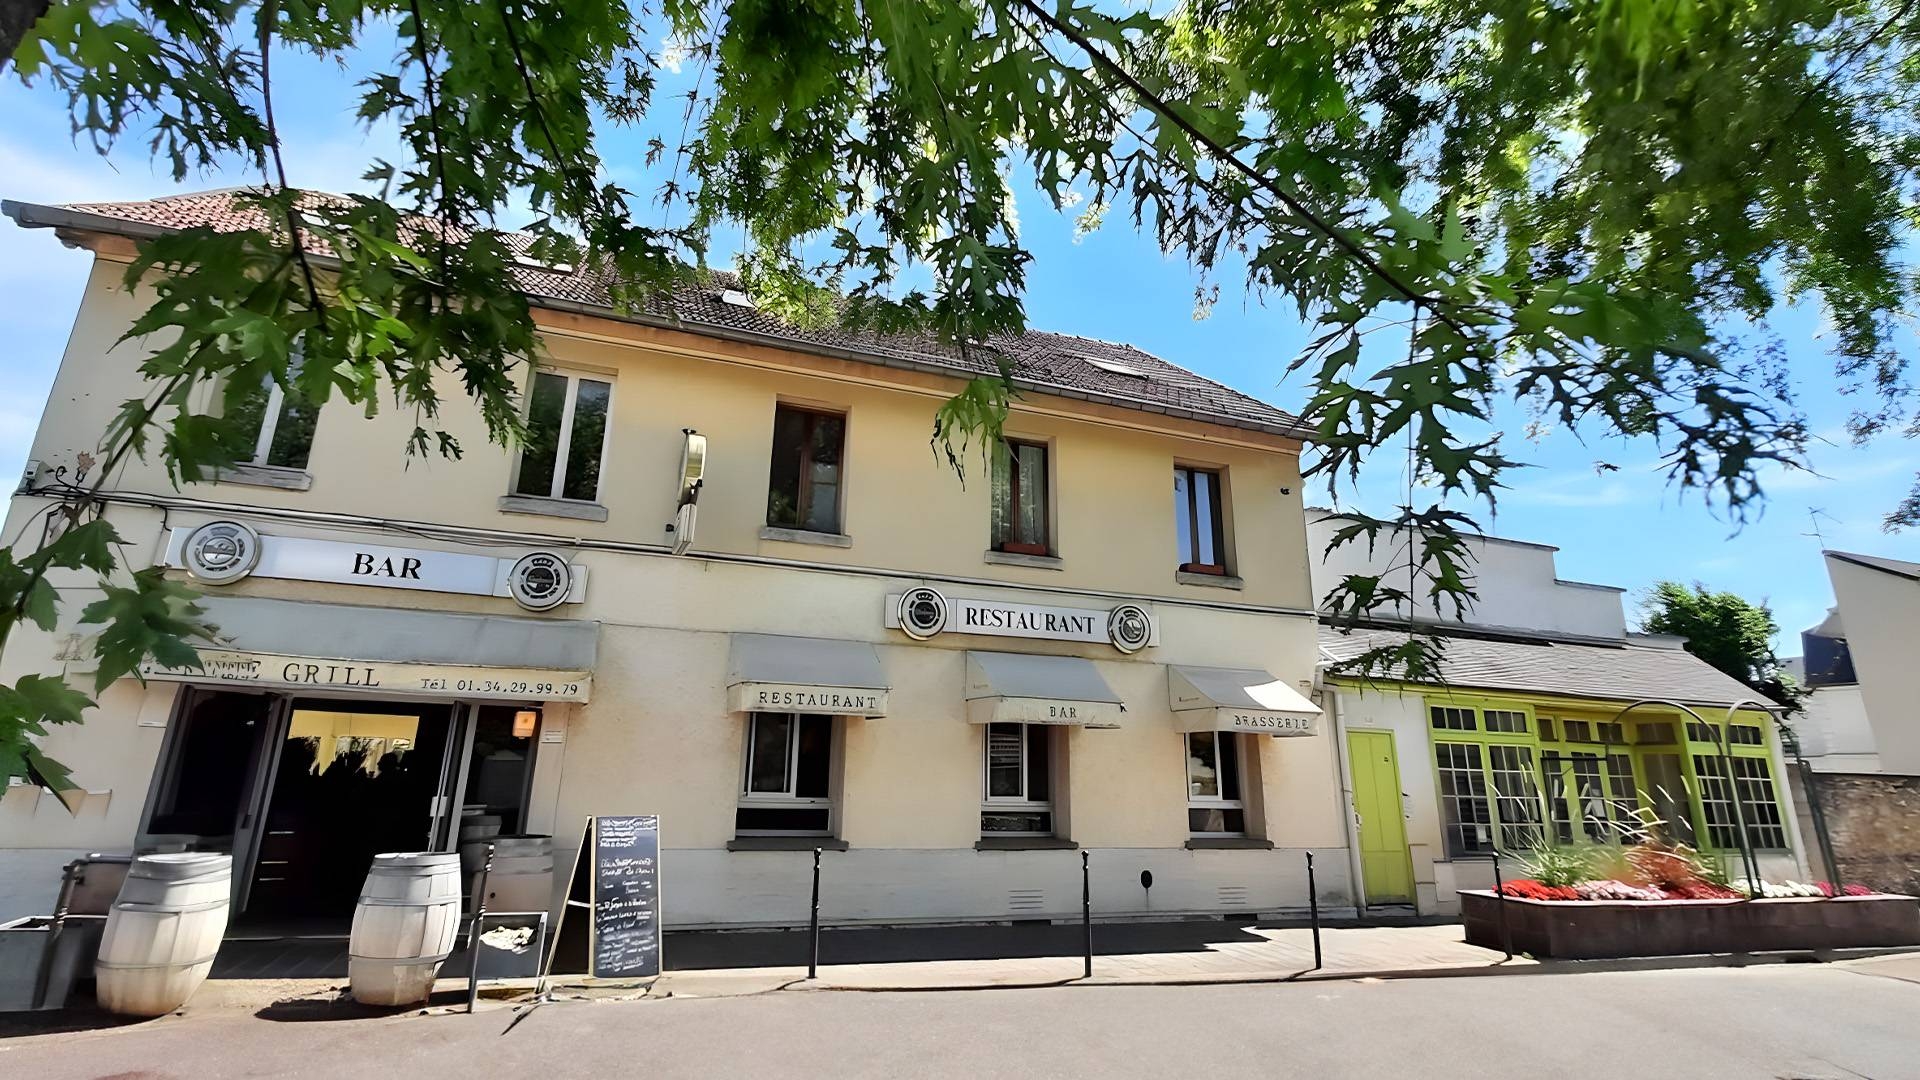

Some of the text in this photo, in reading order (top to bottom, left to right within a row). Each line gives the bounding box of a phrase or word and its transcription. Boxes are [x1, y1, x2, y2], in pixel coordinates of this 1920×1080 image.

[352, 553, 422, 580] BAR
[965, 607, 1095, 634] RESTAURANT
[283, 662, 380, 687] GRILL
[457, 680, 578, 695] 01.34.29.99.79
[759, 691, 876, 709] RESTAURANT
[1049, 706, 1077, 718] BAR
[1234, 715, 1309, 730] BRASSERIE
